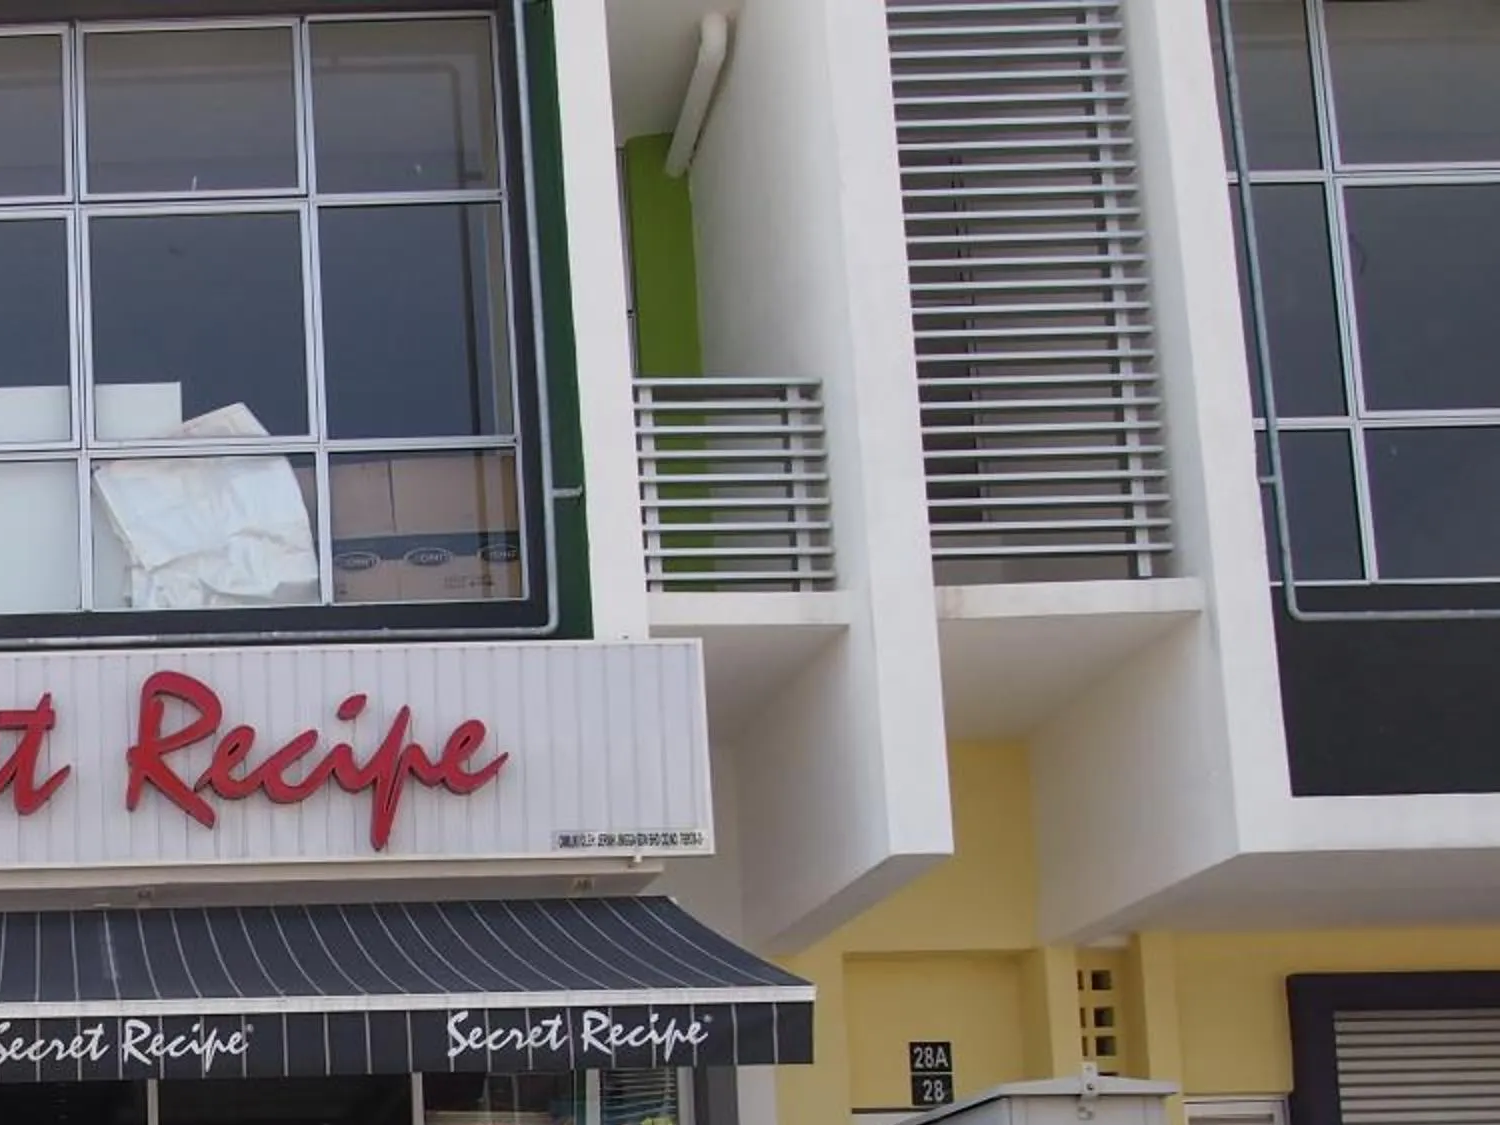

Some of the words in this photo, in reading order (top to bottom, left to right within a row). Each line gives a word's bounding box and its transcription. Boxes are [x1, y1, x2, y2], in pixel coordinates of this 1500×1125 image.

[126, 670, 509, 852] Recipe
[122, 1018, 250, 1073] Recipe
[448, 1010, 569, 1058] Secret
[581, 1009, 710, 1063] Recipe
[913, 1046, 949, 1070] 28A
[922, 1079, 946, 1100] 28
